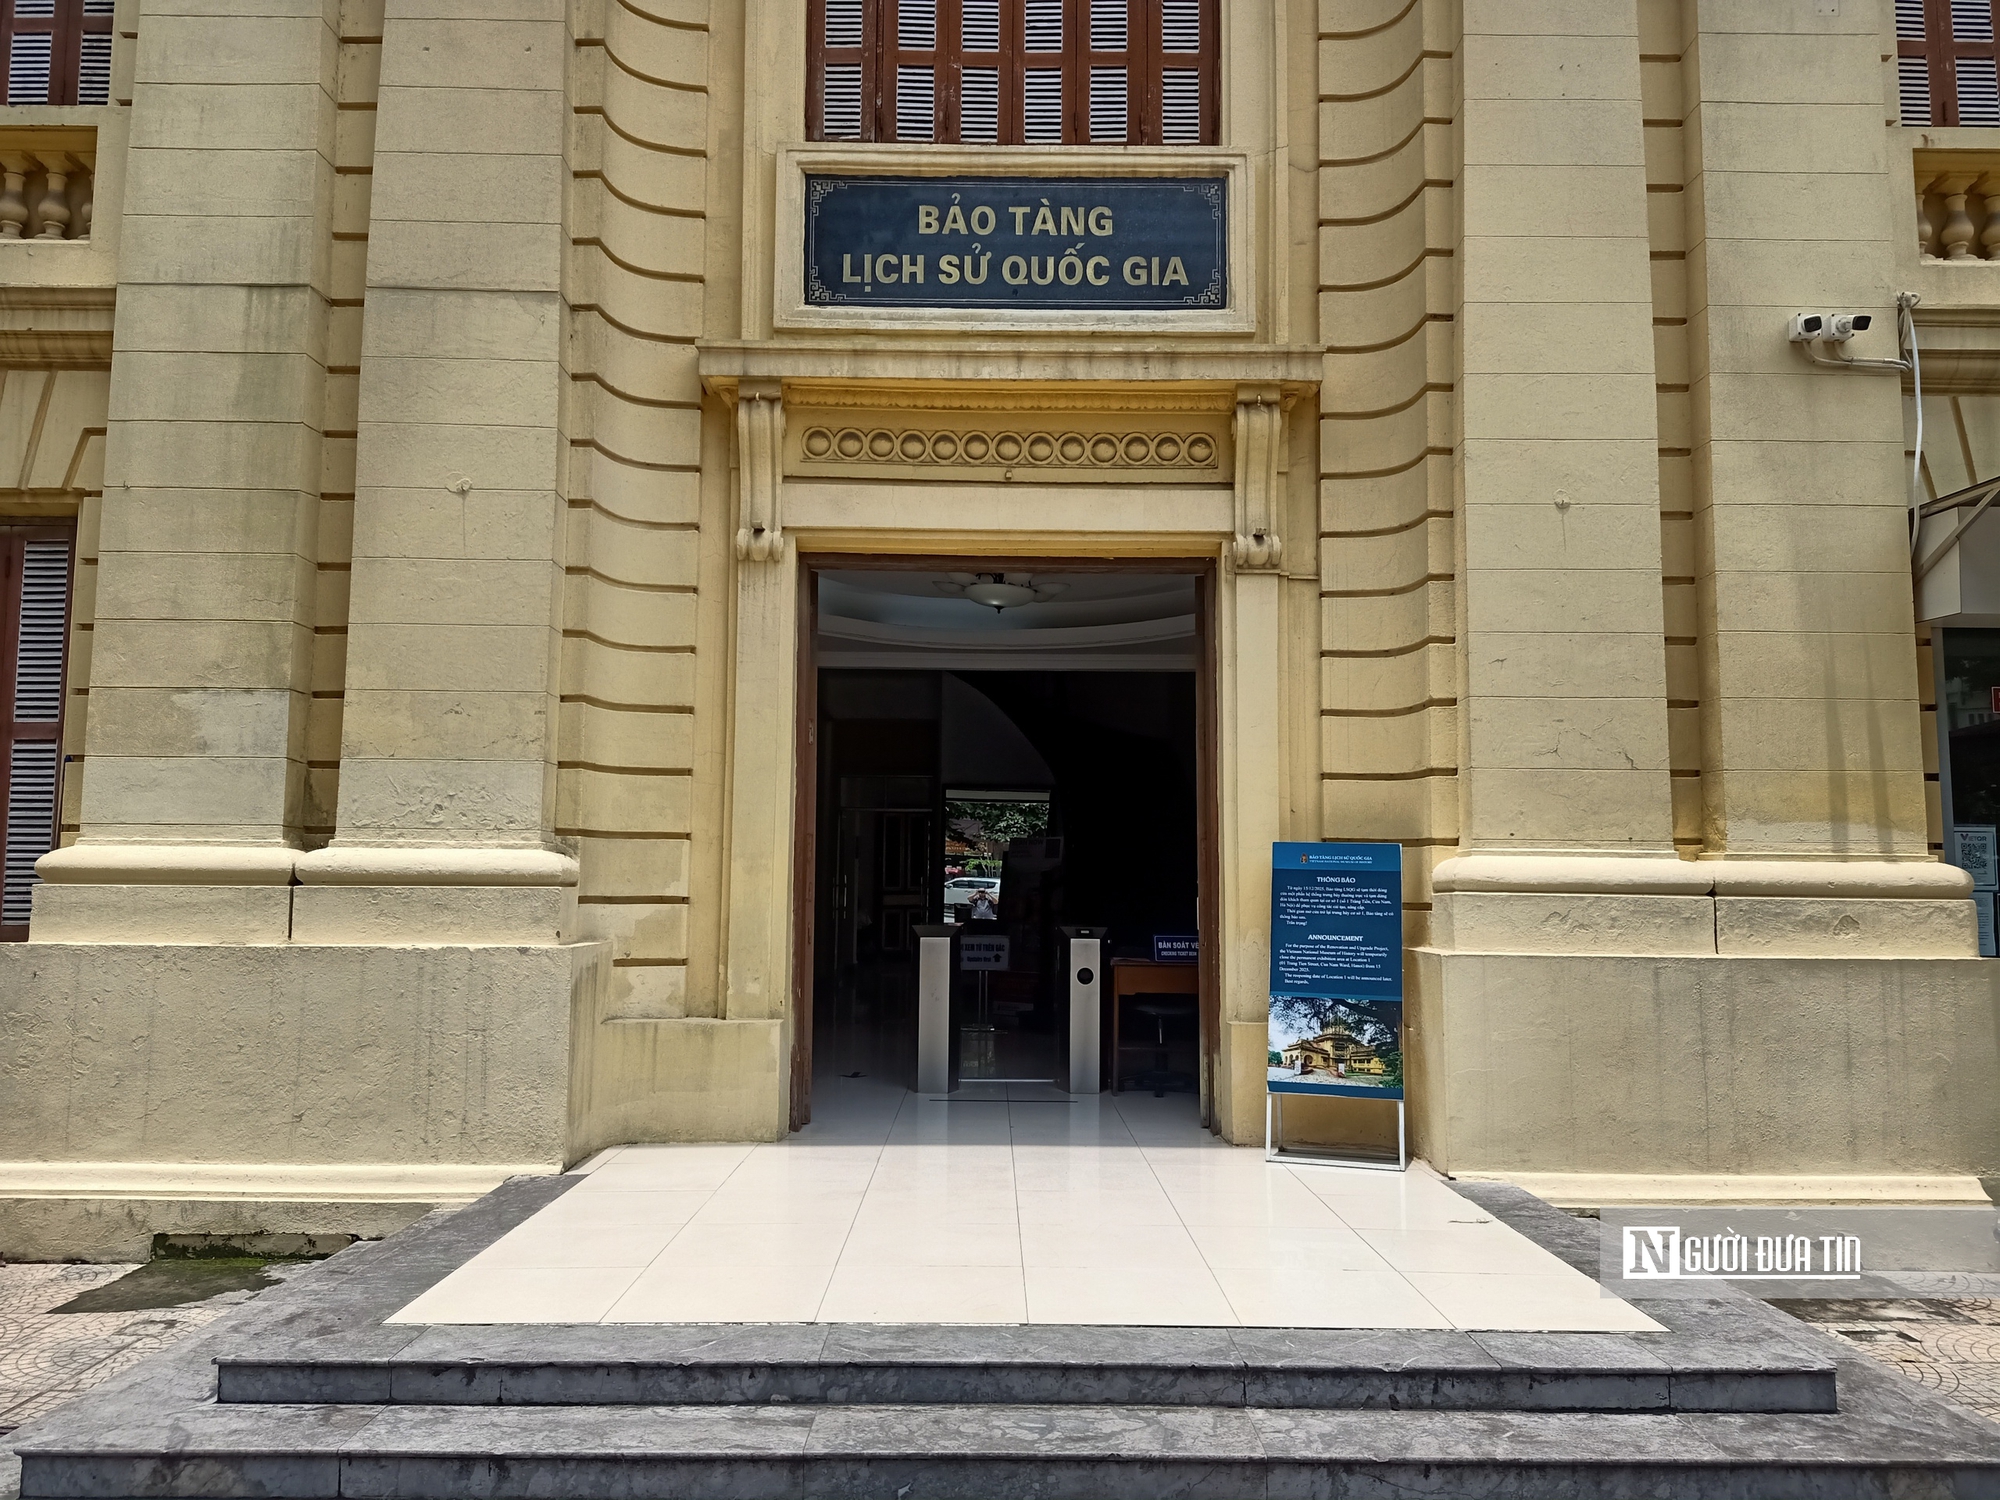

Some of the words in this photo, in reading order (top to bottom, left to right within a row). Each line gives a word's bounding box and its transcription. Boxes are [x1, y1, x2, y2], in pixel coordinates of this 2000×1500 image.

[917, 192, 997, 236] BẢO
[1008, 197, 1114, 237] TÀNG
[842, 253, 925, 293] LỊCH
[937, 242, 993, 286] SỬ
[1001, 242, 1110, 286] QUỐC
[1122, 255, 1189, 286] GIA
[1158, 940, 1171, 948] BÀN
[1172, 940, 1189, 949] SOÁT
